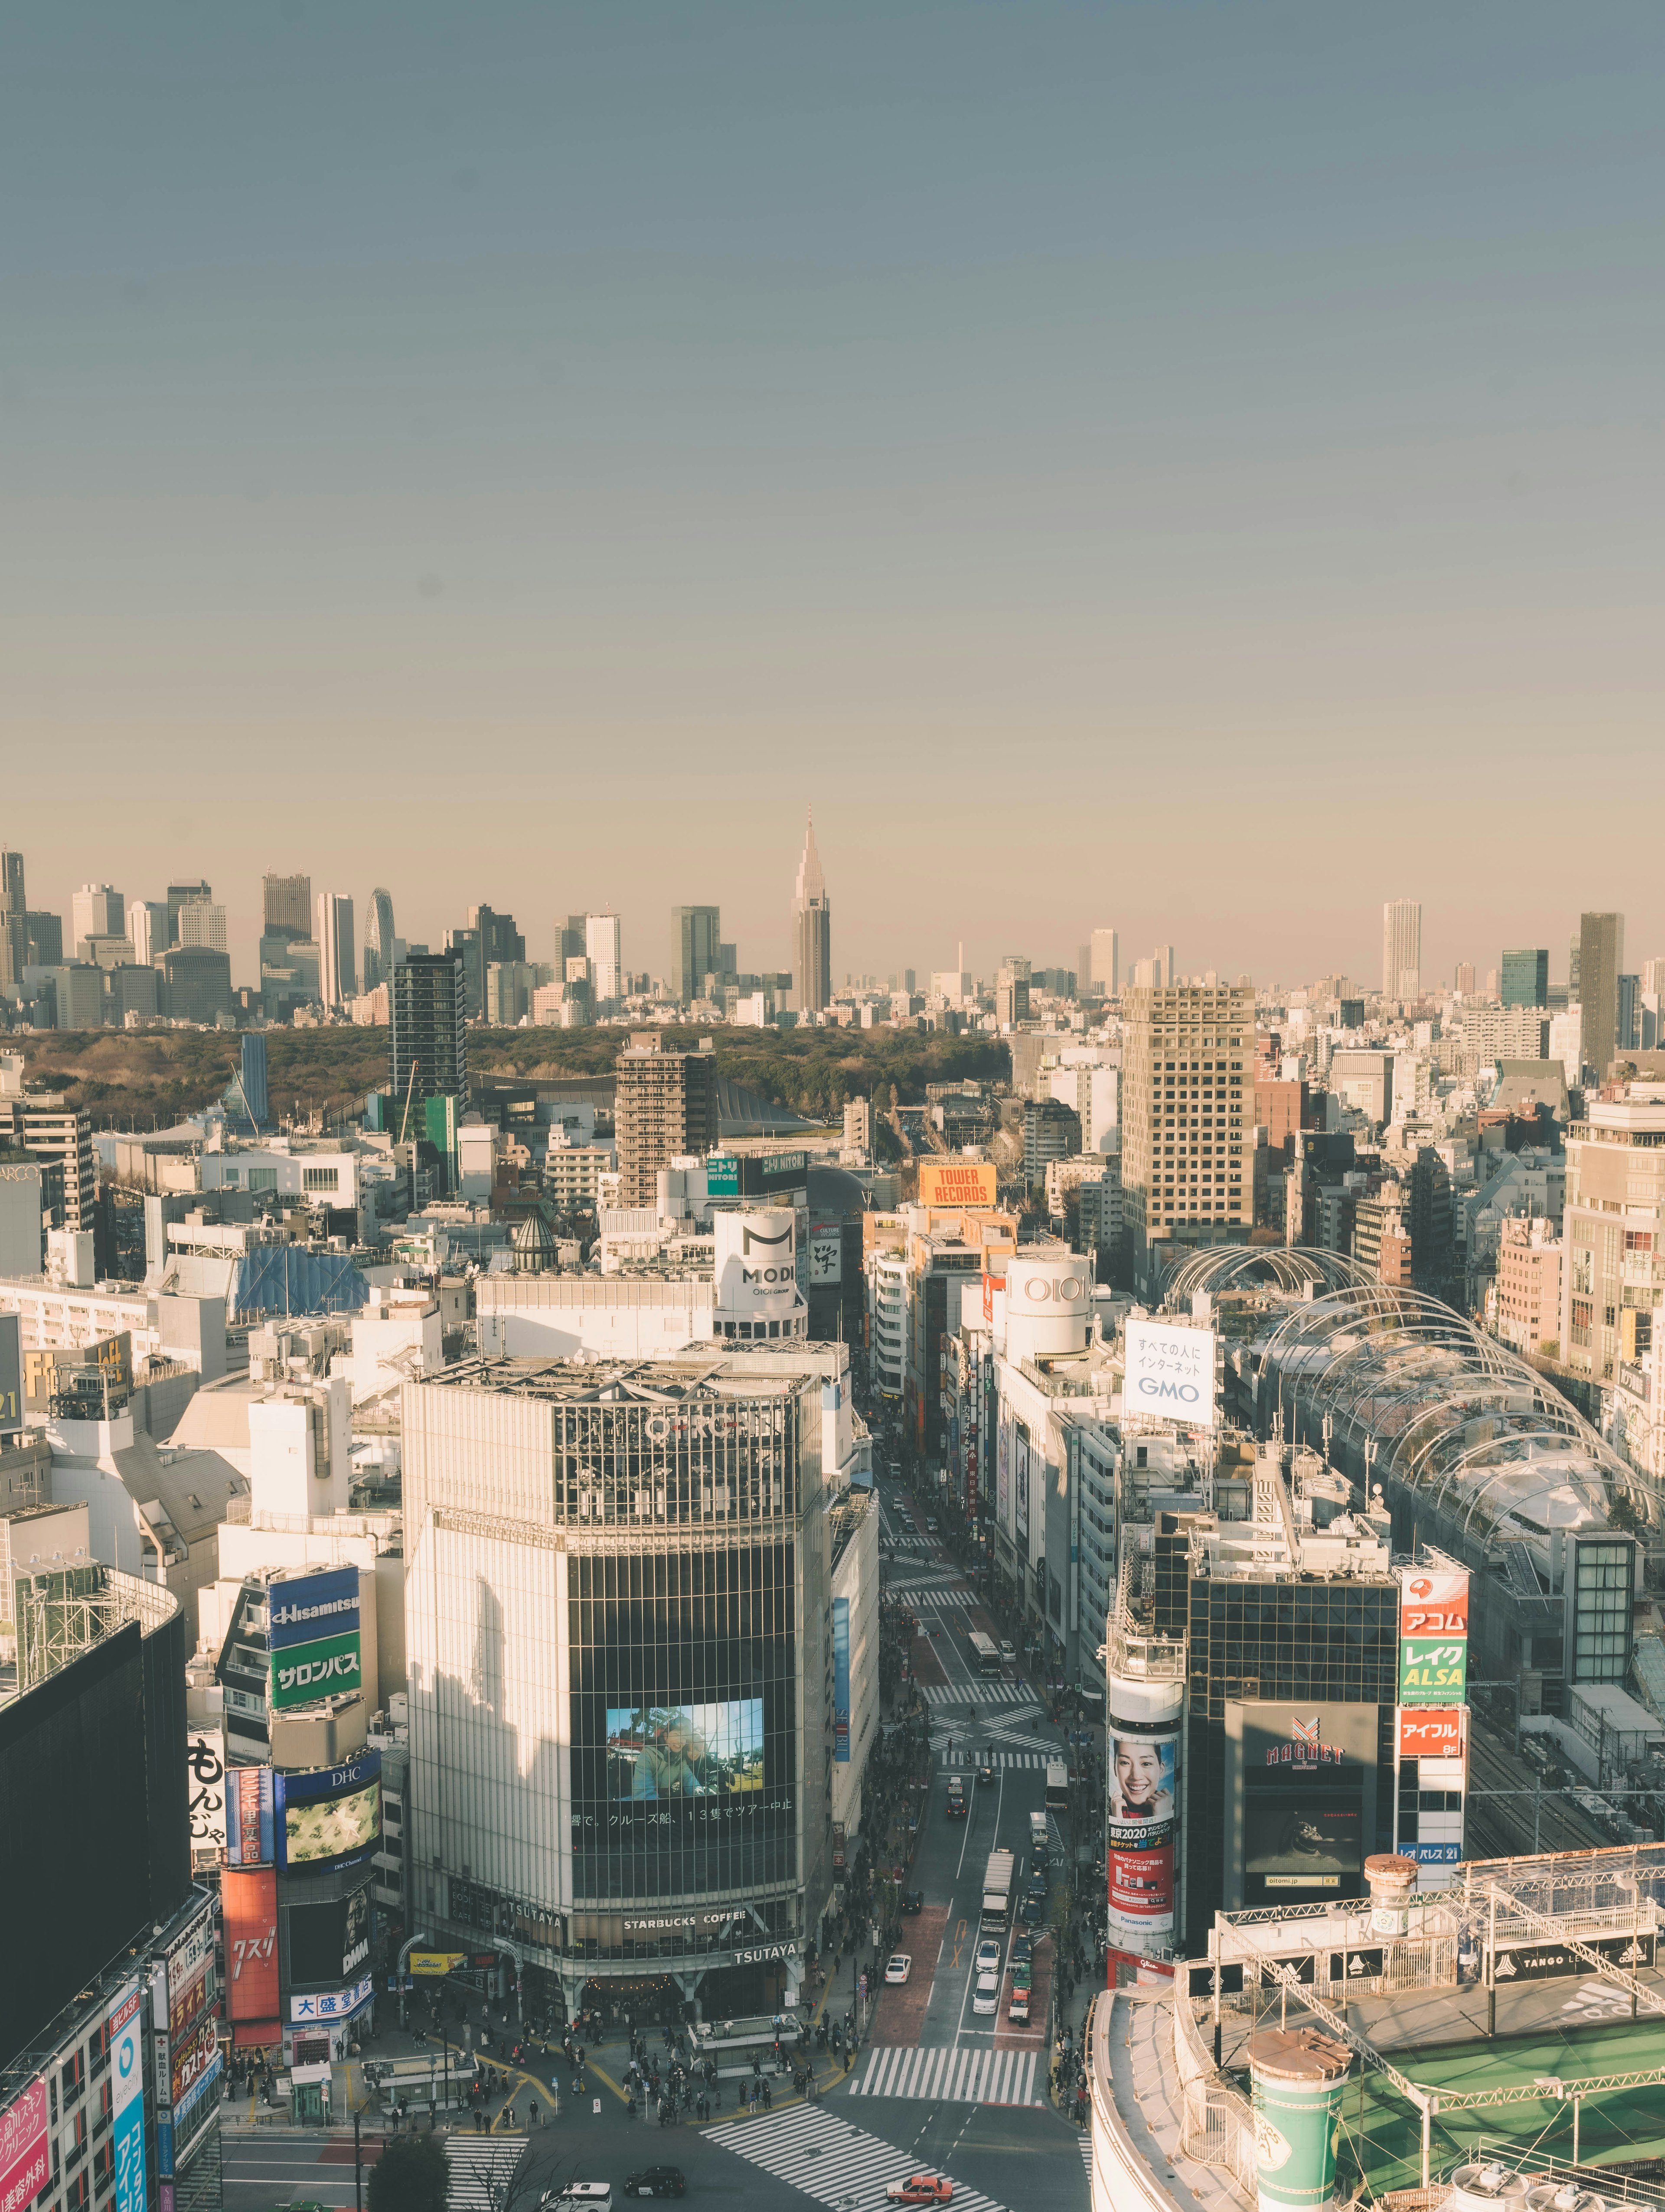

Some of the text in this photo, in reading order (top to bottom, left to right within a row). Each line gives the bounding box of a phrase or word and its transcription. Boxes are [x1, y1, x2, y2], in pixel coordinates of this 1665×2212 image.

[708, 1161, 737, 1173] ニトリ
[764, 1153, 804, 1173] ニトリ NITORI
[939, 1170, 979, 1185] TOWER
[935, 1186, 987, 1202] RECORDS
[743, 1266, 794, 1284] MODI
[1139, 1338, 1201, 1360] すべての人に
[1139, 1356, 1201, 1377] インターネット
[1138, 1377, 1200, 1403] GMO
[272, 1596, 360, 1625] Hisamitsu
[1407, 1613, 1465, 1631] アコム
[1406, 1646, 1463, 1665] レイク
[278, 1652, 360, 1690] サロンパス
[1403, 1668, 1463, 1686] ALSA
[836, 1708, 848, 1752] SEIBU
[1403, 1724, 1457, 1738] アイフル
[1266, 1743, 1346, 1766] MAGNET
[1443, 1745, 1457, 1754] 8F
[332, 1766, 361, 1787] DHC
[188, 1739, 225, 1845] もんじゃ
[1110, 1827, 1147, 1840] 東京2020
[1148, 1826, 1171, 1837] パラリンピック
[346, 1856, 362, 1867] Channel
[509, 1902, 561, 1929] TSUTAYA
[624, 1910, 746, 1930] STARBUCKS COFFEE
[1120, 1916, 1152, 1926] Panasonic
[232, 1926, 277, 1981] クスリ
[343, 1937, 369, 1976] DMM
[734, 1943, 796, 1964] TSUTAYA
[1140, 1959, 1158, 1969] Glico
[1524, 1956, 1564, 1968] TANGO
[298, 1979, 369, 2014] 大盛堂書店
[113, 1994, 137, 2033] 当ビル5F
[158, 2052, 167, 2096] 献血ルーム
[180, 2049, 204, 2091] ガスト
[5, 2112, 39, 2163] クリニック
